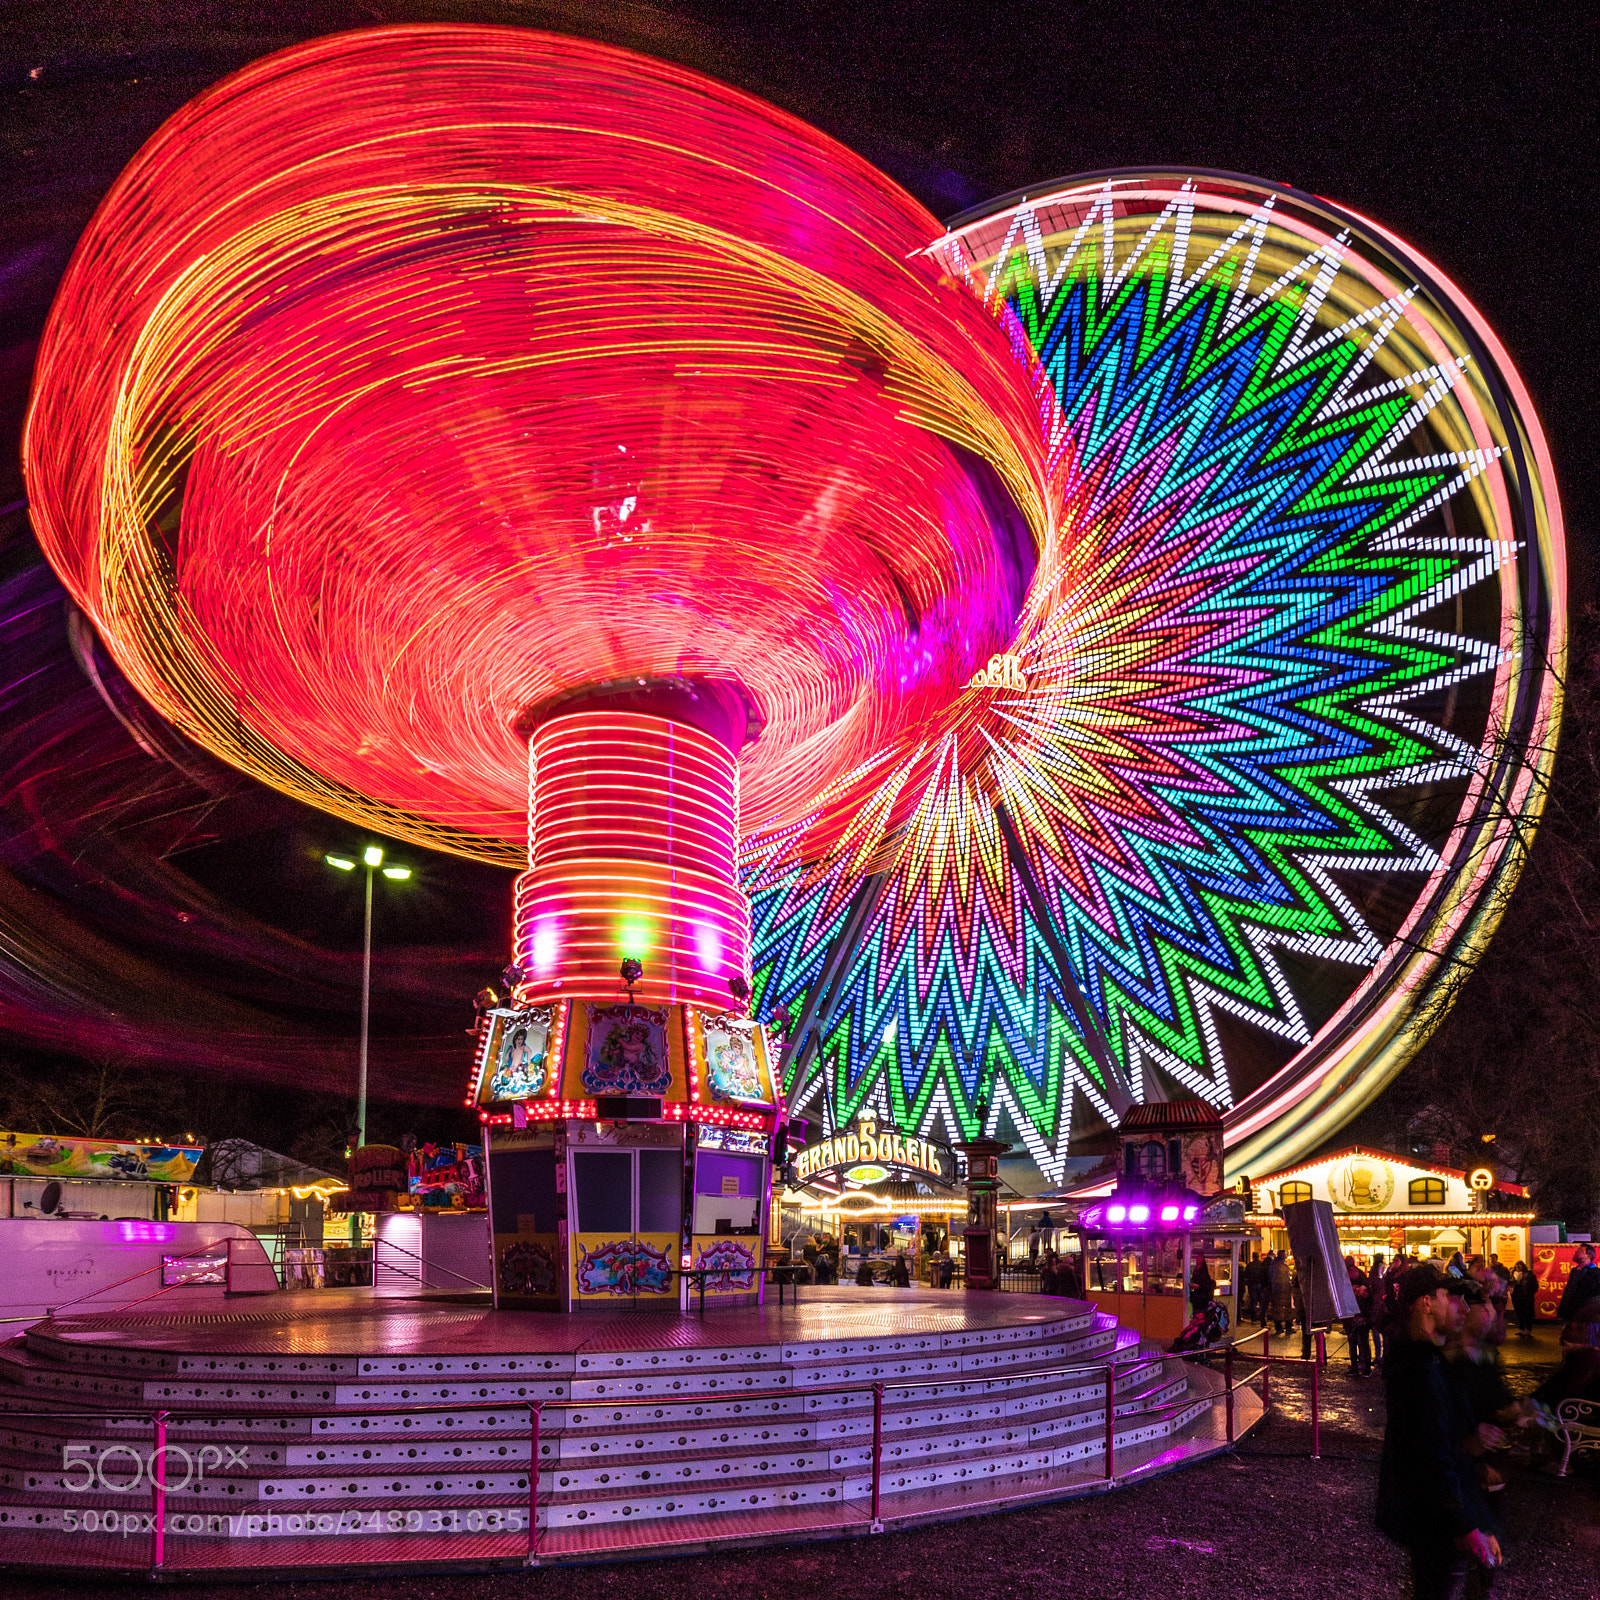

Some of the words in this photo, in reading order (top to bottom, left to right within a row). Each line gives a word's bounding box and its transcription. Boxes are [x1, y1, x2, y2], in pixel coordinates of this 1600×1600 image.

[798, 1134, 860, 1180] GRAND
[859, 1121, 942, 1177] SOLEIL
[1538, 1277, 1568, 1293] Spe
